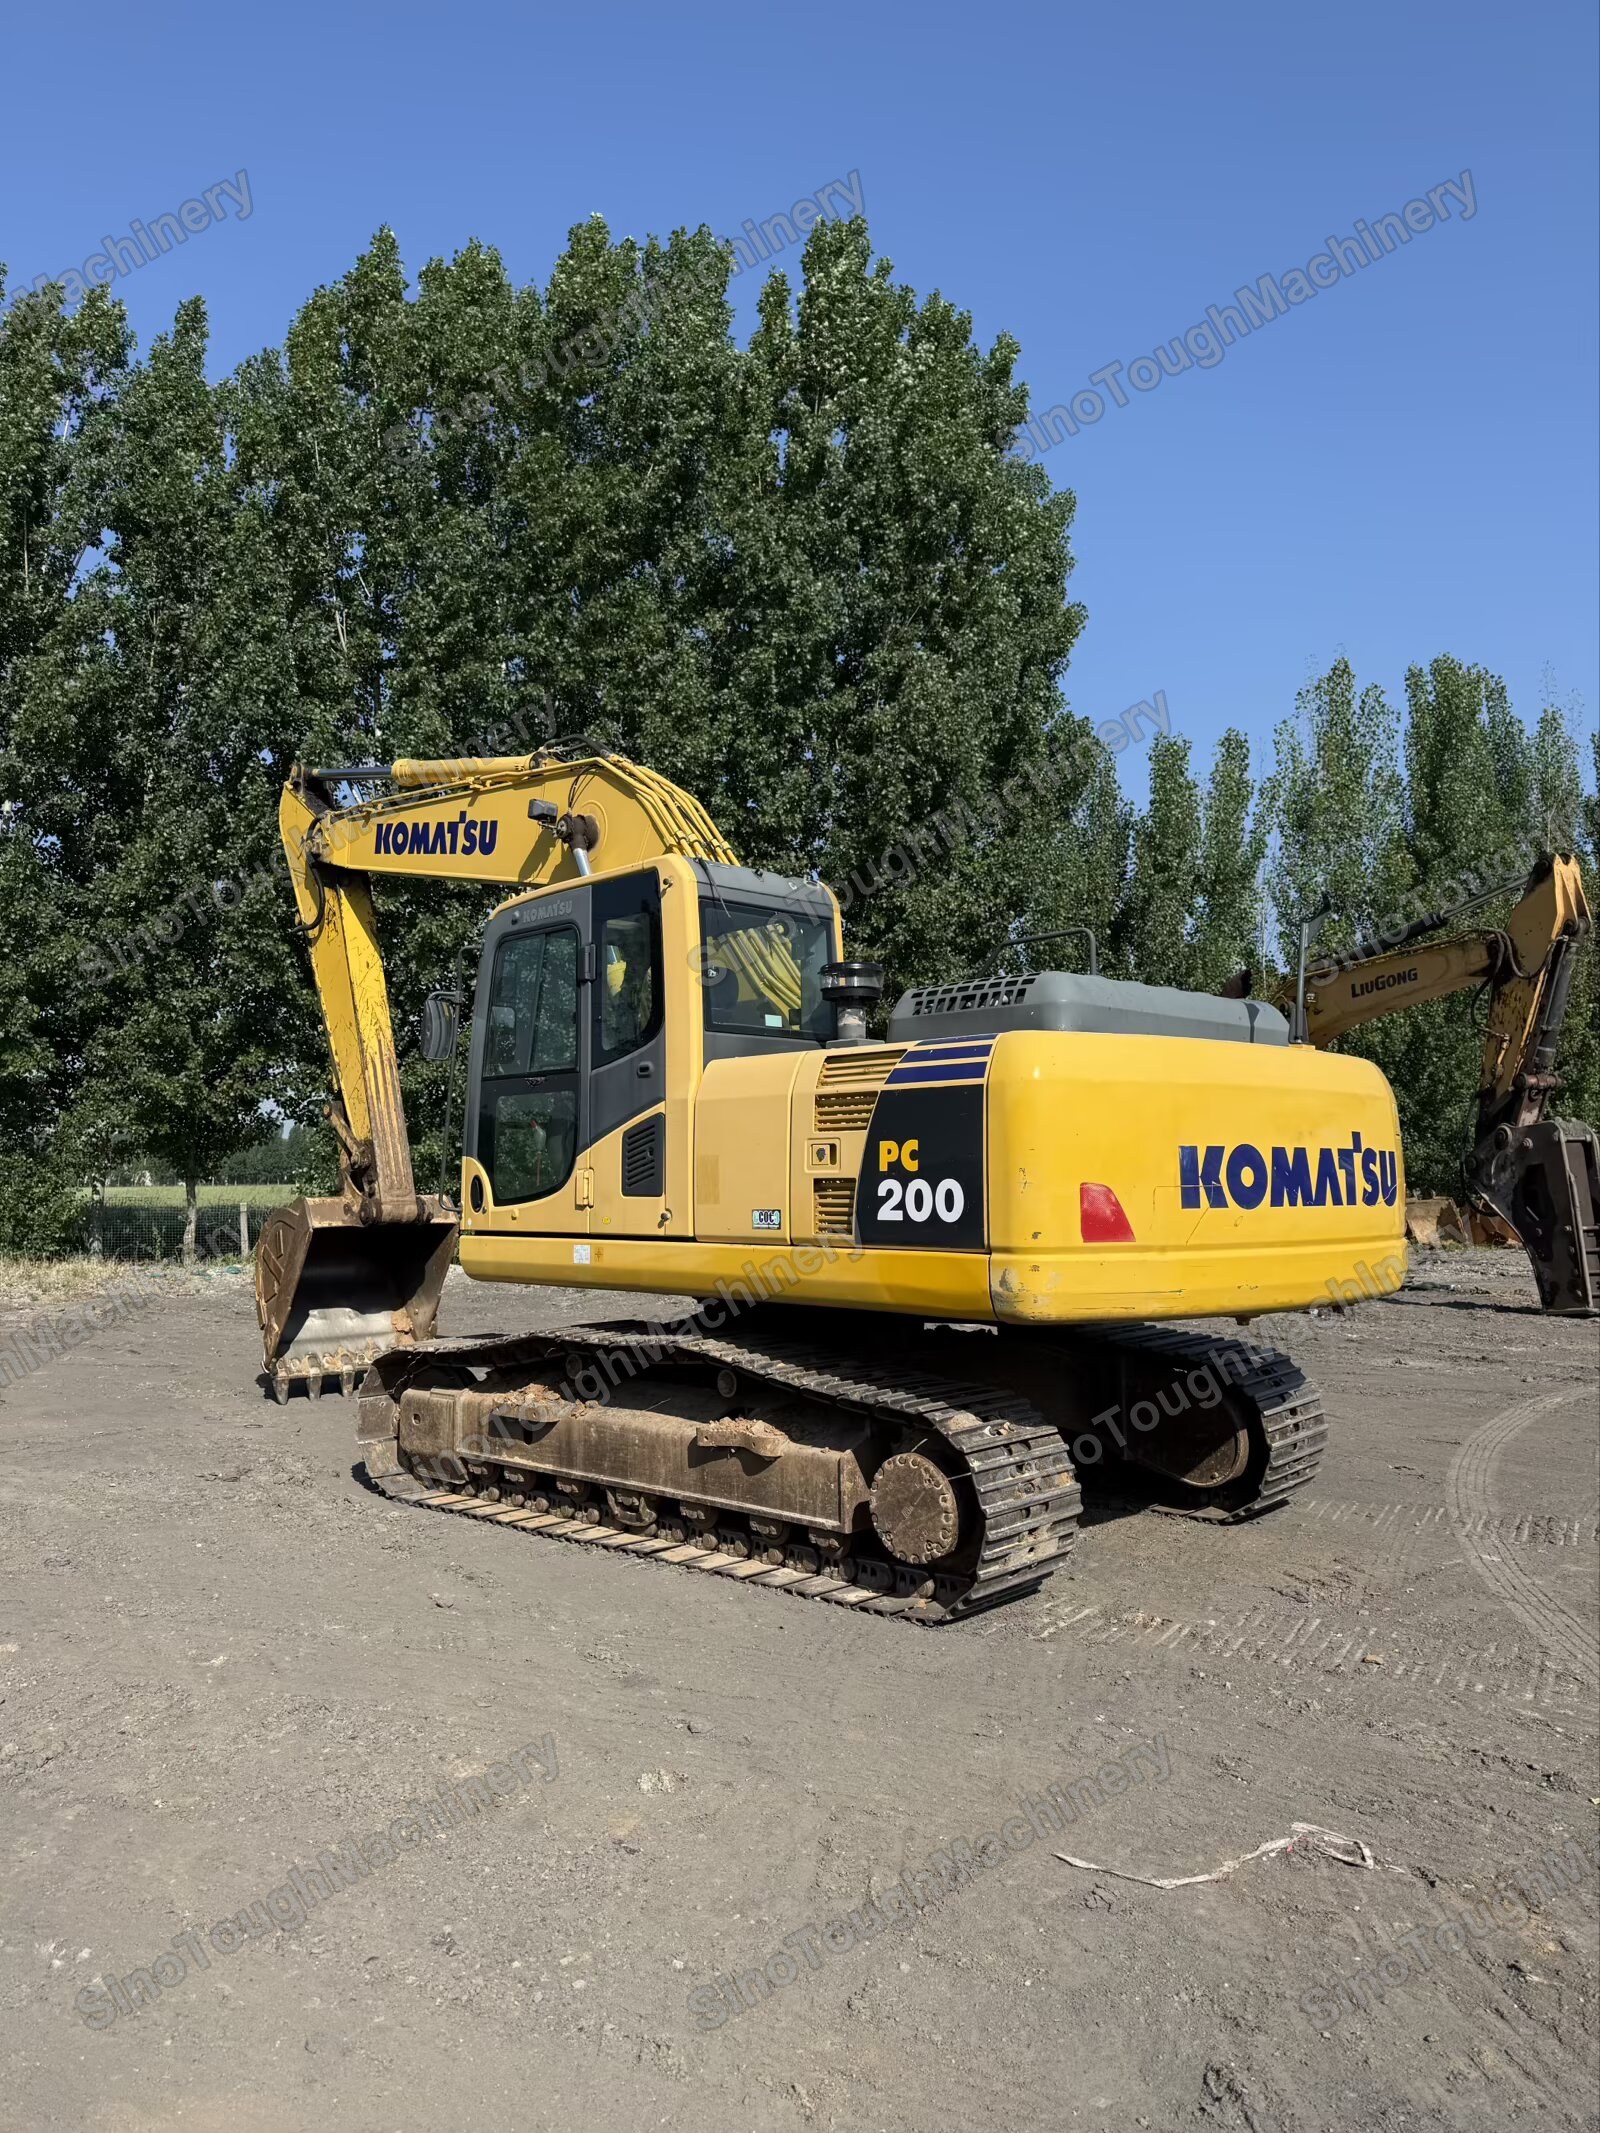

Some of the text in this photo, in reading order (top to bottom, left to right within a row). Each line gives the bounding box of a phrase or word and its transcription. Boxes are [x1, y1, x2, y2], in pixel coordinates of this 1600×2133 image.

[374, 810, 498, 855] KOMATSU
[523, 900, 572, 923] KOMATSU
[879, 1139, 918, 1172] PC
[1178, 1131, 1398, 1210] KOMATSU
[877, 1178, 964, 1223] 200
